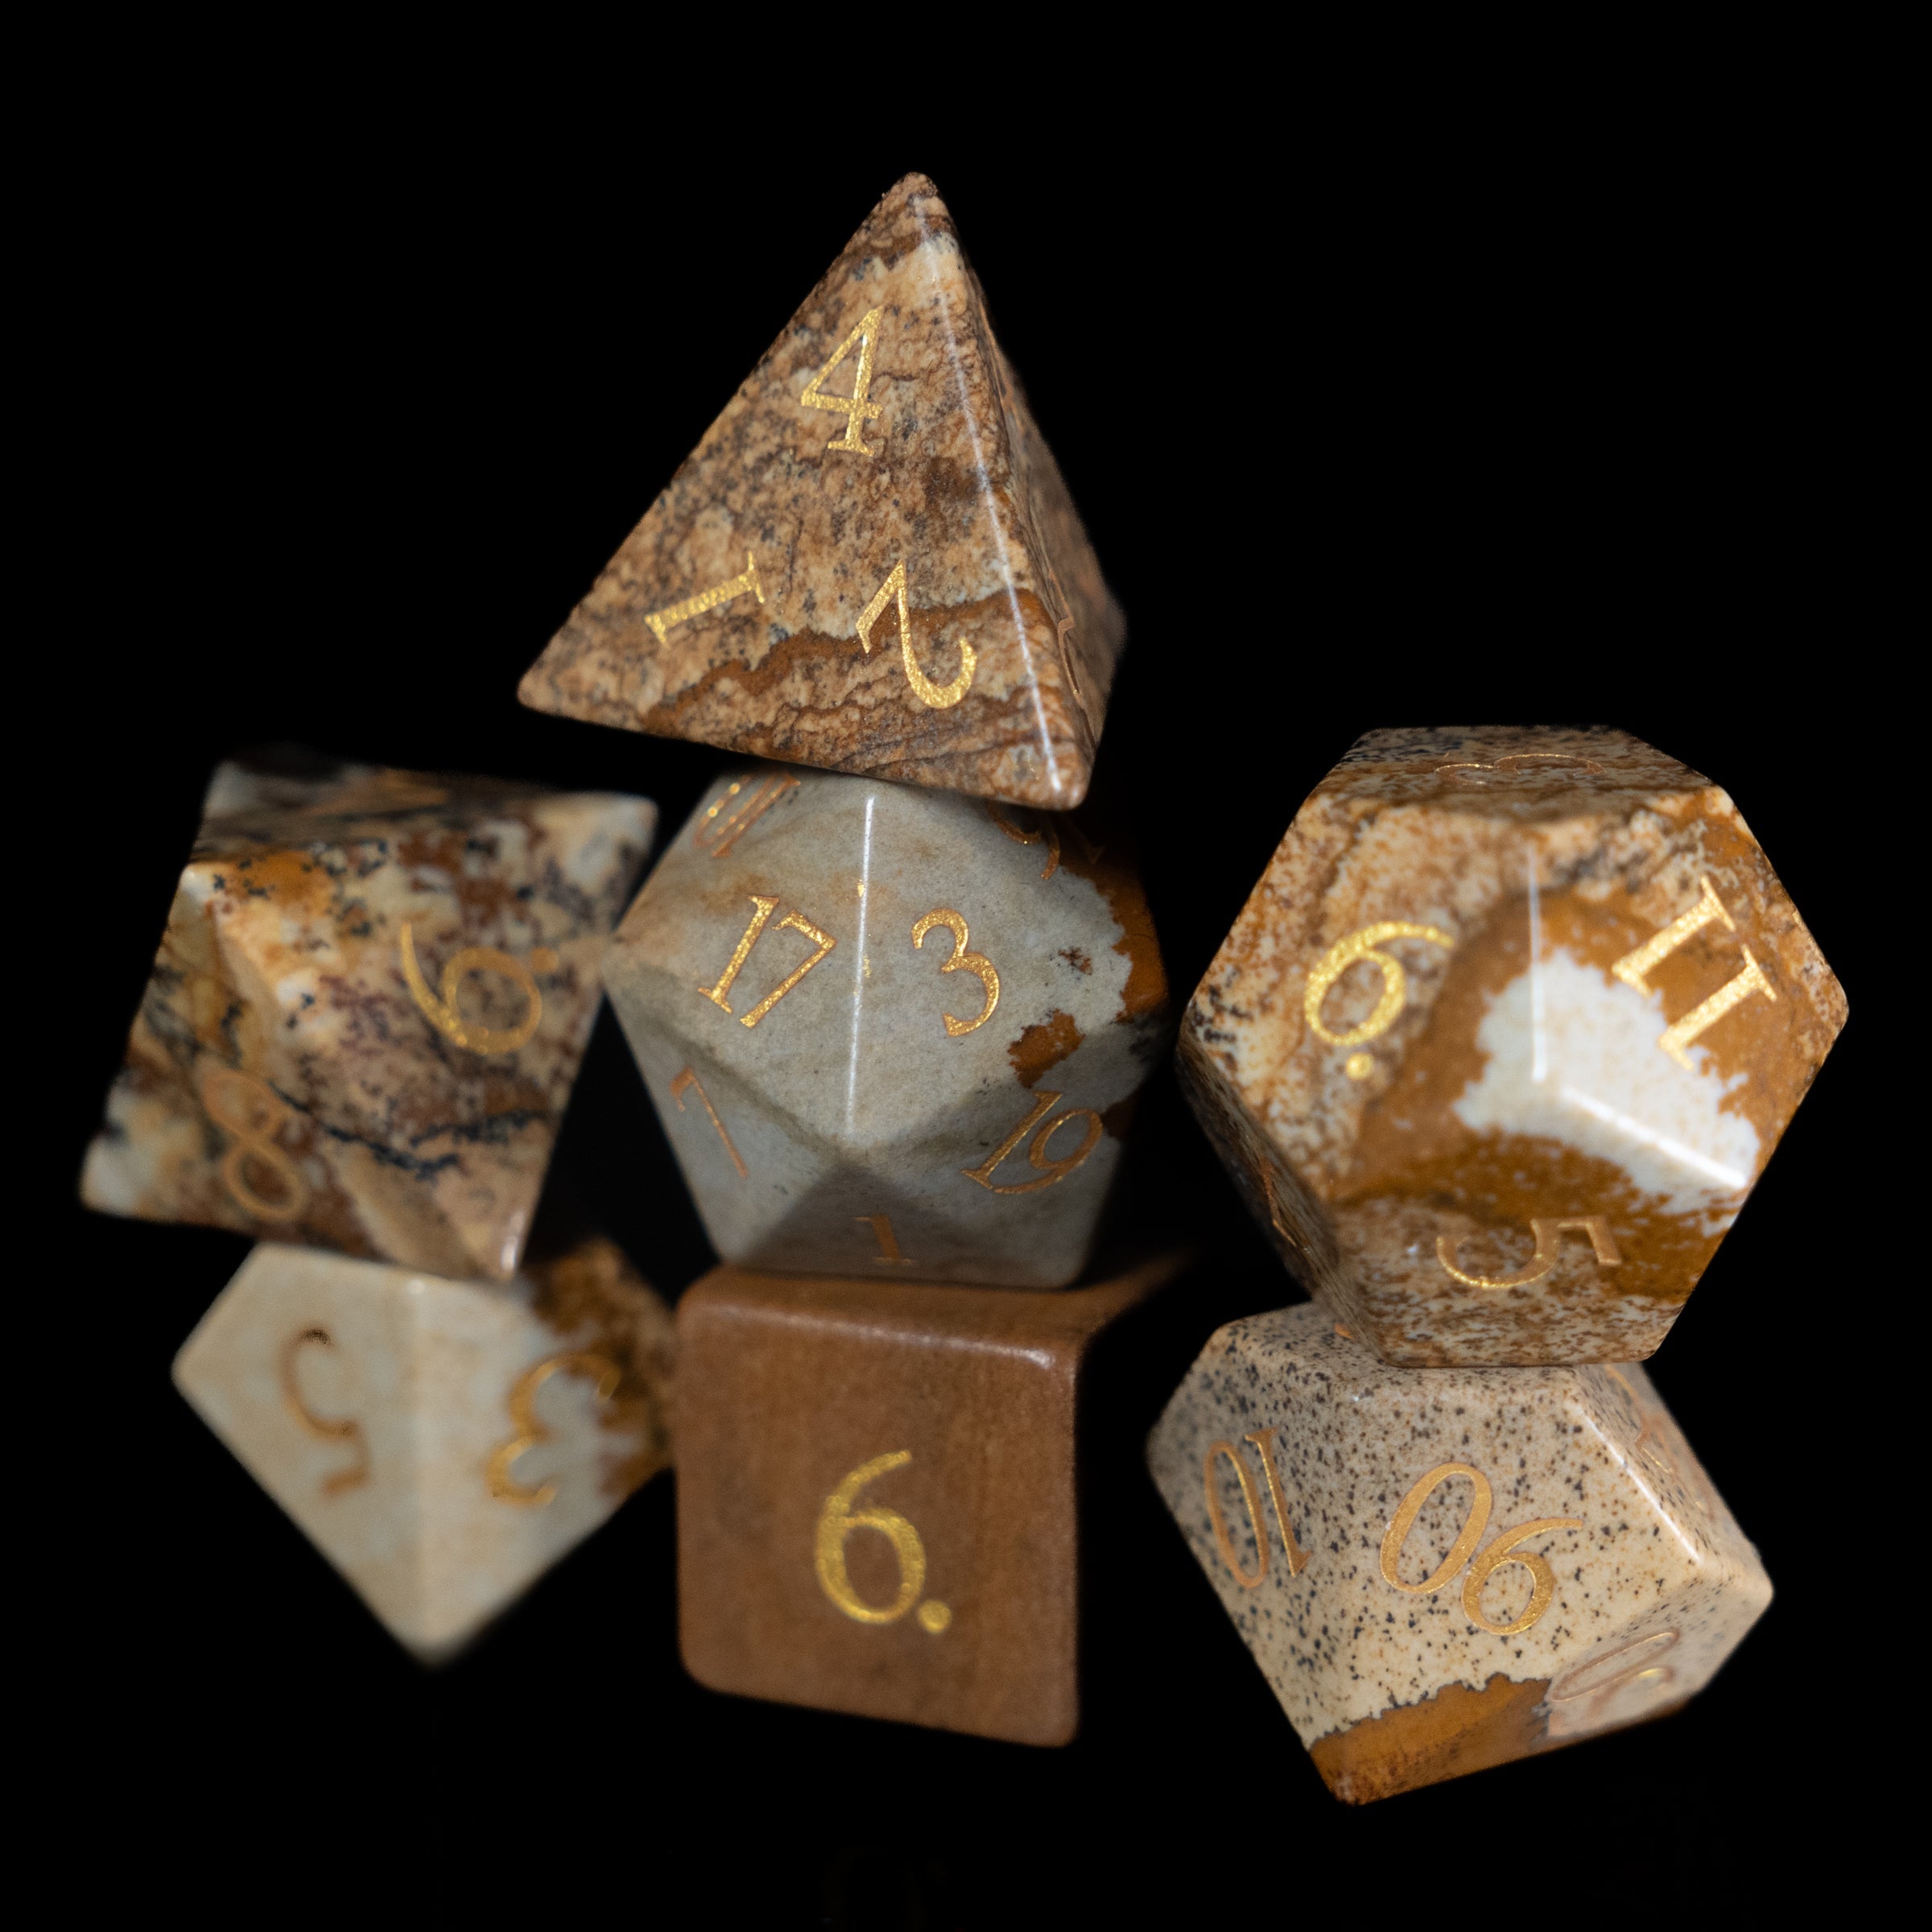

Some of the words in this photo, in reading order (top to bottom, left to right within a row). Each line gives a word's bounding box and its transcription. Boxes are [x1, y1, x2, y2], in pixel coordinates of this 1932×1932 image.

[801, 304, 884, 456] 4
[645, 551, 765, 646] 1
[856, 559, 977, 709] 2
[698, 894, 837, 1029] 17
[910, 907, 1000, 1037] 3
[1612, 874, 1777, 1072] 11
[200, 1069, 308, 1220] 8
[669, 1066, 749, 1179] 7
[961, 1091, 1104, 1195] 19
[855, 1214, 914, 1266] 1
[1436, 1215, 1622, 1288] 5
[487, 1351, 620, 1506] 3
[1203, 1426, 1313, 1589] 10
